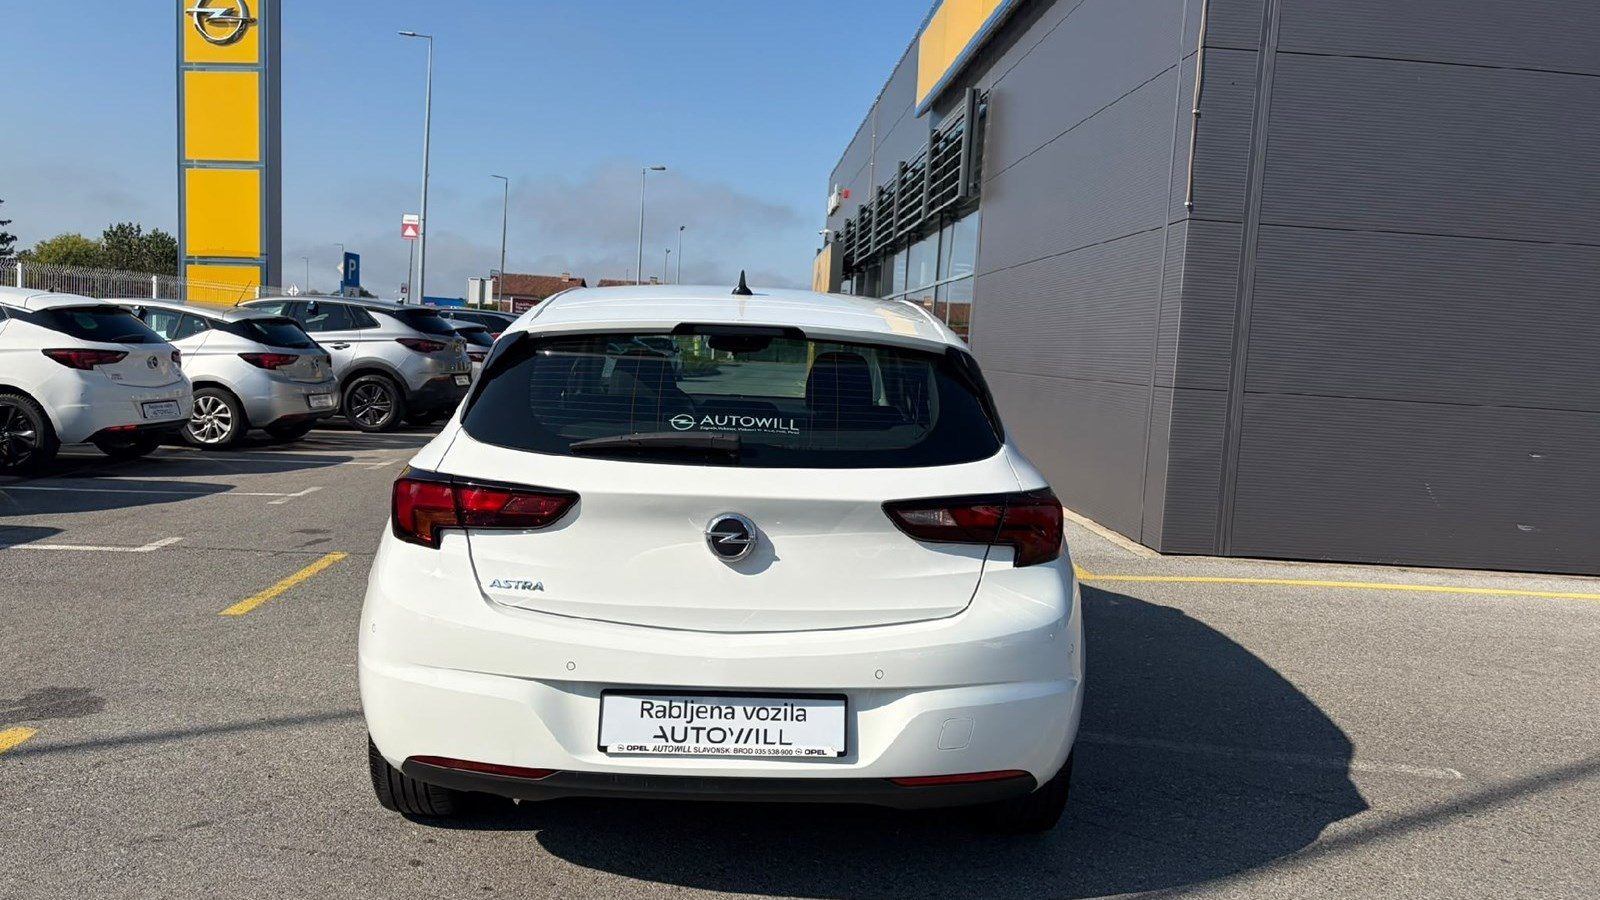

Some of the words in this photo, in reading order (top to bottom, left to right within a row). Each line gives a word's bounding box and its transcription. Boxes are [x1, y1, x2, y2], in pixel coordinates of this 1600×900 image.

[348, 259, 357, 280] P
[700, 415, 800, 431] AUTOWILL
[489, 579, 545, 592] ASTRA
[640, 701, 735, 724] Rabljena
[743, 703, 808, 722] vozila
[653, 725, 793, 746] AUTOWILL
[652, 745, 692, 753] AUTOWILL
[693, 746, 731, 754] SLAVONSK
